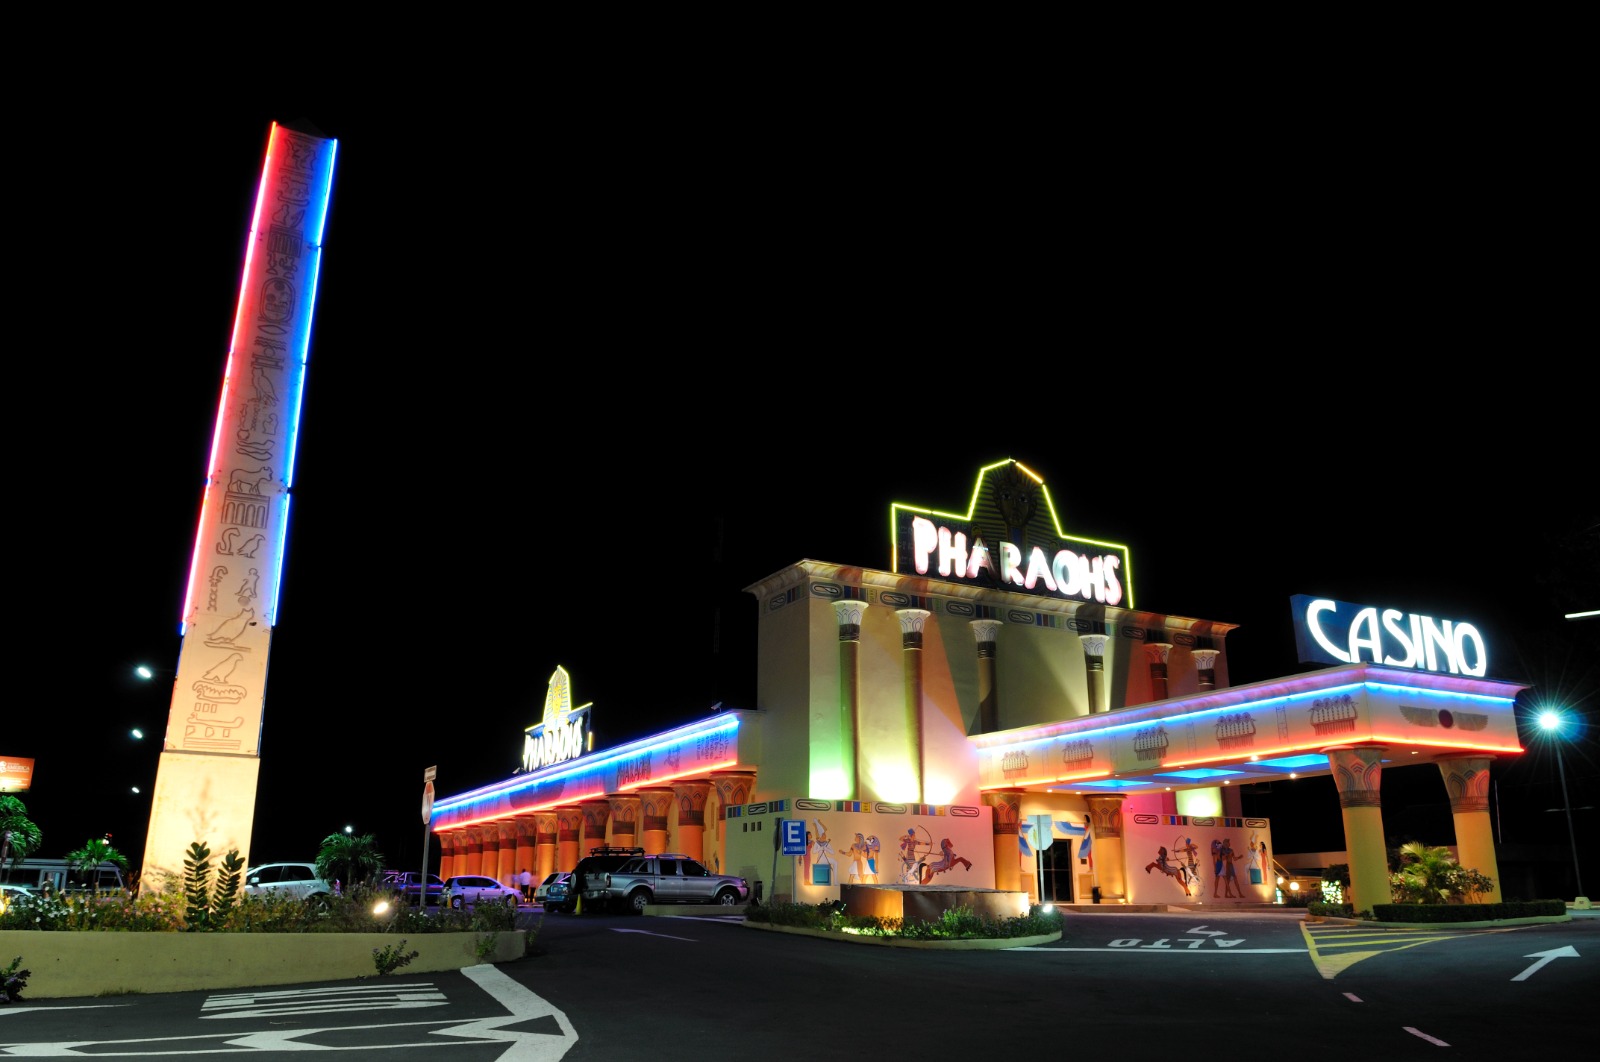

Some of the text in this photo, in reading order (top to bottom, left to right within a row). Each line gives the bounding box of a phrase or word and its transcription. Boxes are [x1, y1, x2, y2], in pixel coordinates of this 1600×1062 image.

[912, 516, 1122, 606] PHARAOHS
[1306, 599, 1487, 677] CASINO
[787, 822, 801, 843] E
[1107, 938, 1247, 949] ALTO
